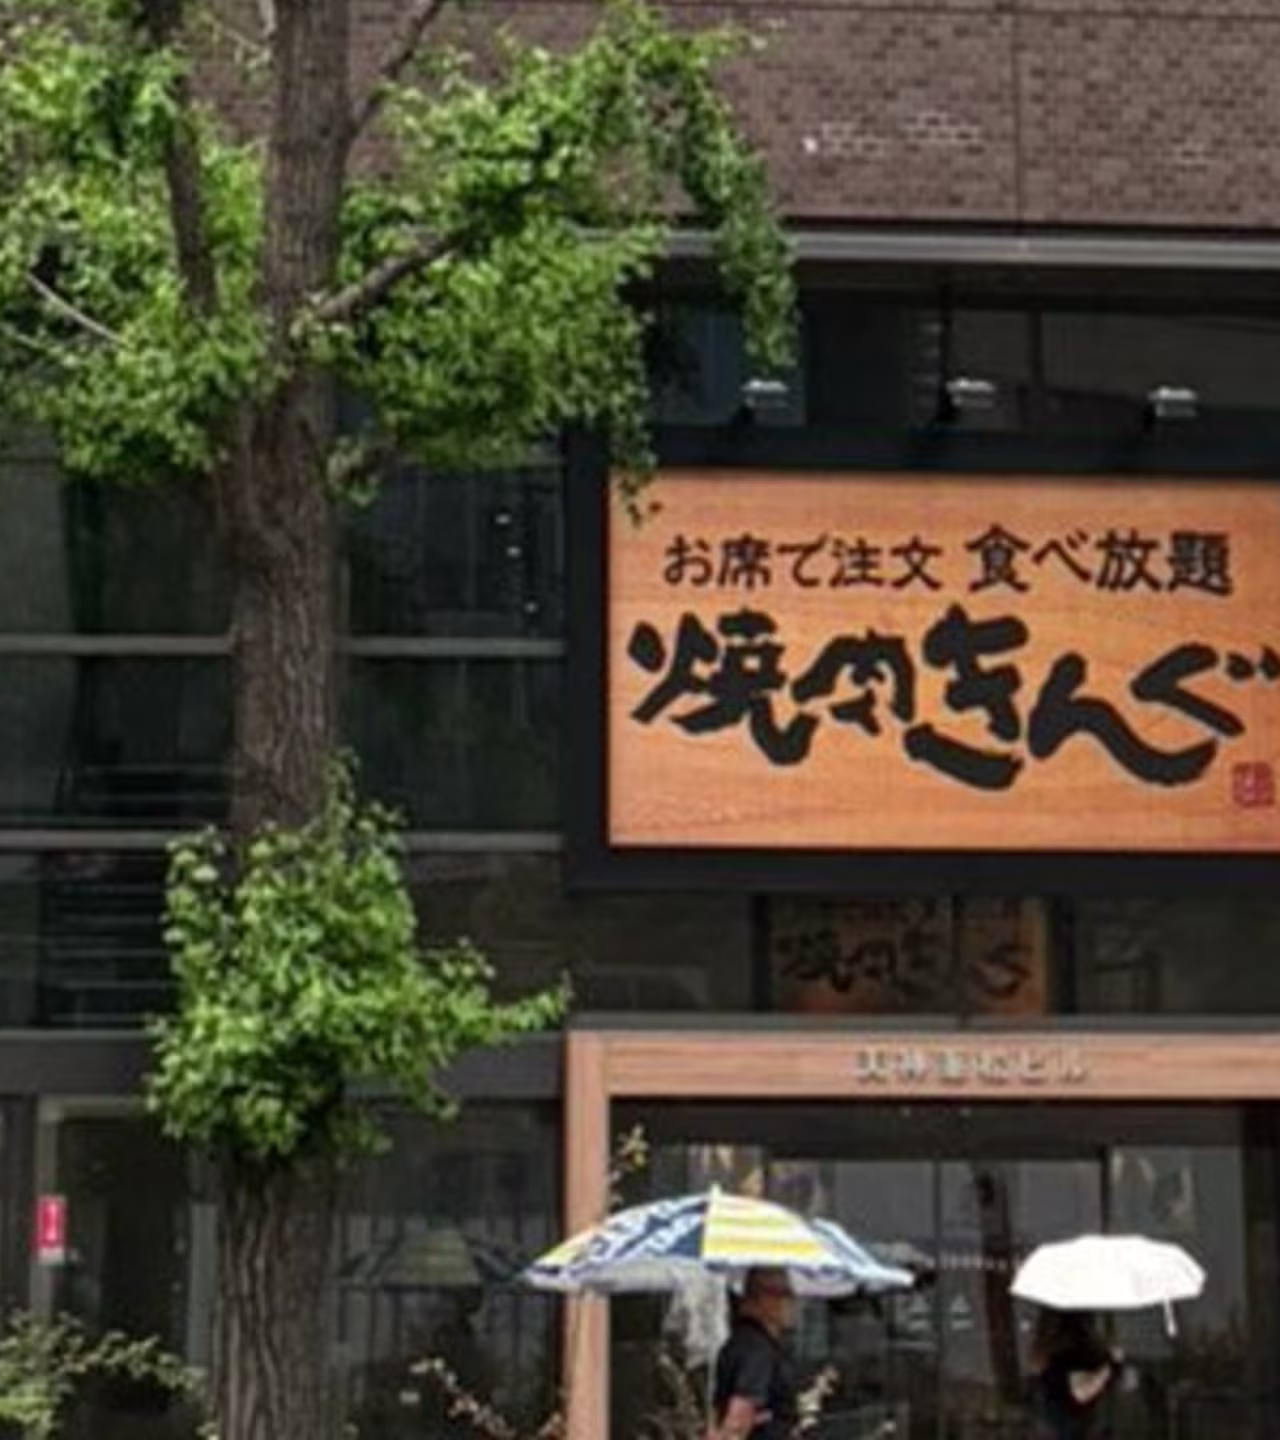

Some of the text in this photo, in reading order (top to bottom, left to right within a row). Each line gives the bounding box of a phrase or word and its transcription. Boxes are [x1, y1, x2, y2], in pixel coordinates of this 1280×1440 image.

[662, 523, 1234, 597] お席で注文 食べ放題
